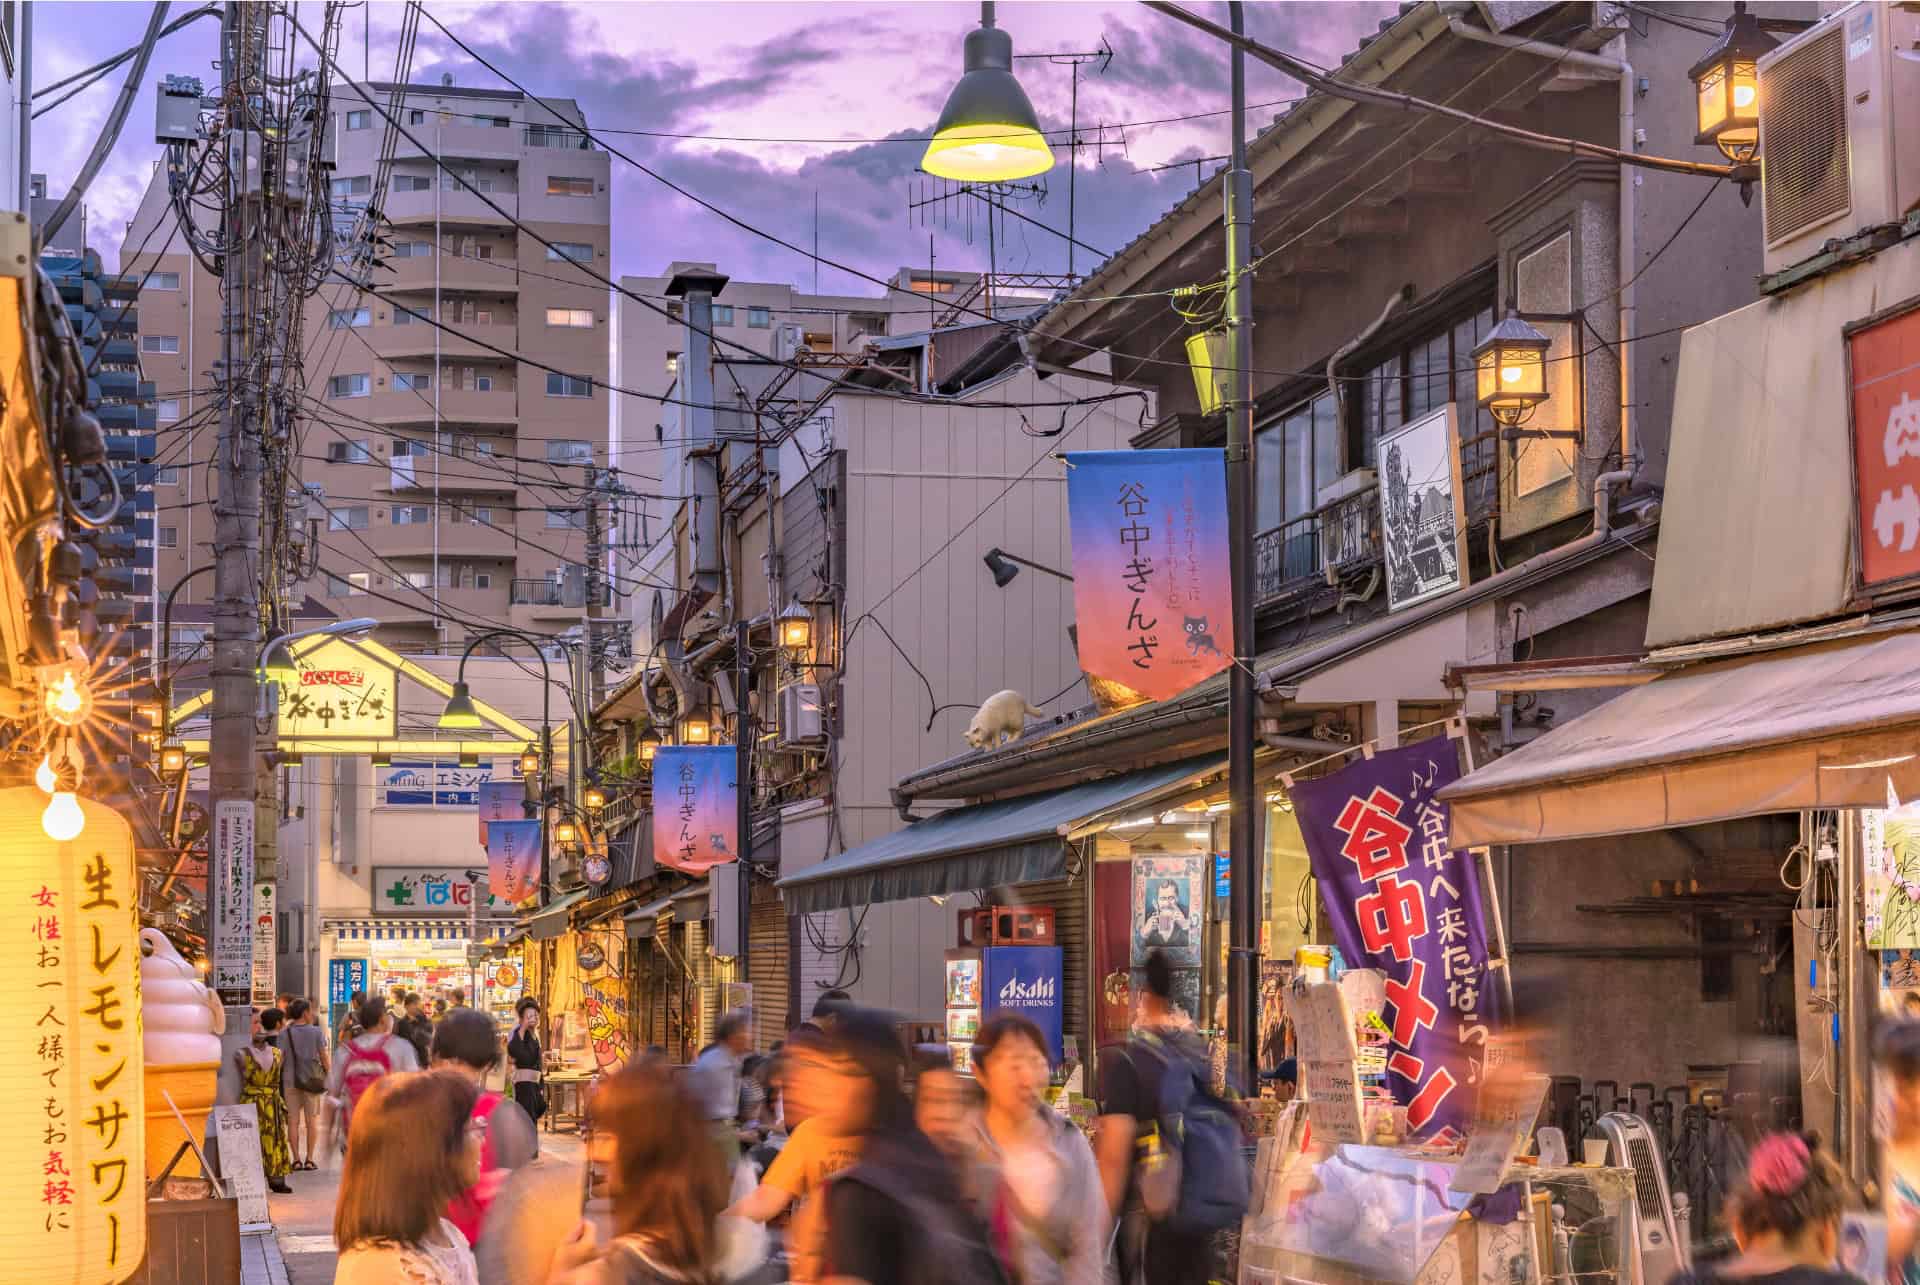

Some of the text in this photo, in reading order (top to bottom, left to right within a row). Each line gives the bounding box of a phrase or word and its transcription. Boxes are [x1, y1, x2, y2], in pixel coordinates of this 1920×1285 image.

[1117, 480, 1158, 669] 谷中ぎんざ
[287, 680, 387, 728] 谷中ぎんざ
[437, 772, 492, 788] エミング
[678, 763, 697, 861] 谷中ぎんざ
[1000, 977, 1054, 999] Asahi
[1333, 785, 1463, 1147] 谷中メン
[1415, 801, 1488, 1044] 谷中へ来たなら
[31, 885, 76, 1232] 女性お一人様でもお気軽に
[80, 855, 130, 1265] 生レモンサワー
[1000, 999, 1054, 1007] SOFT DRINKS
